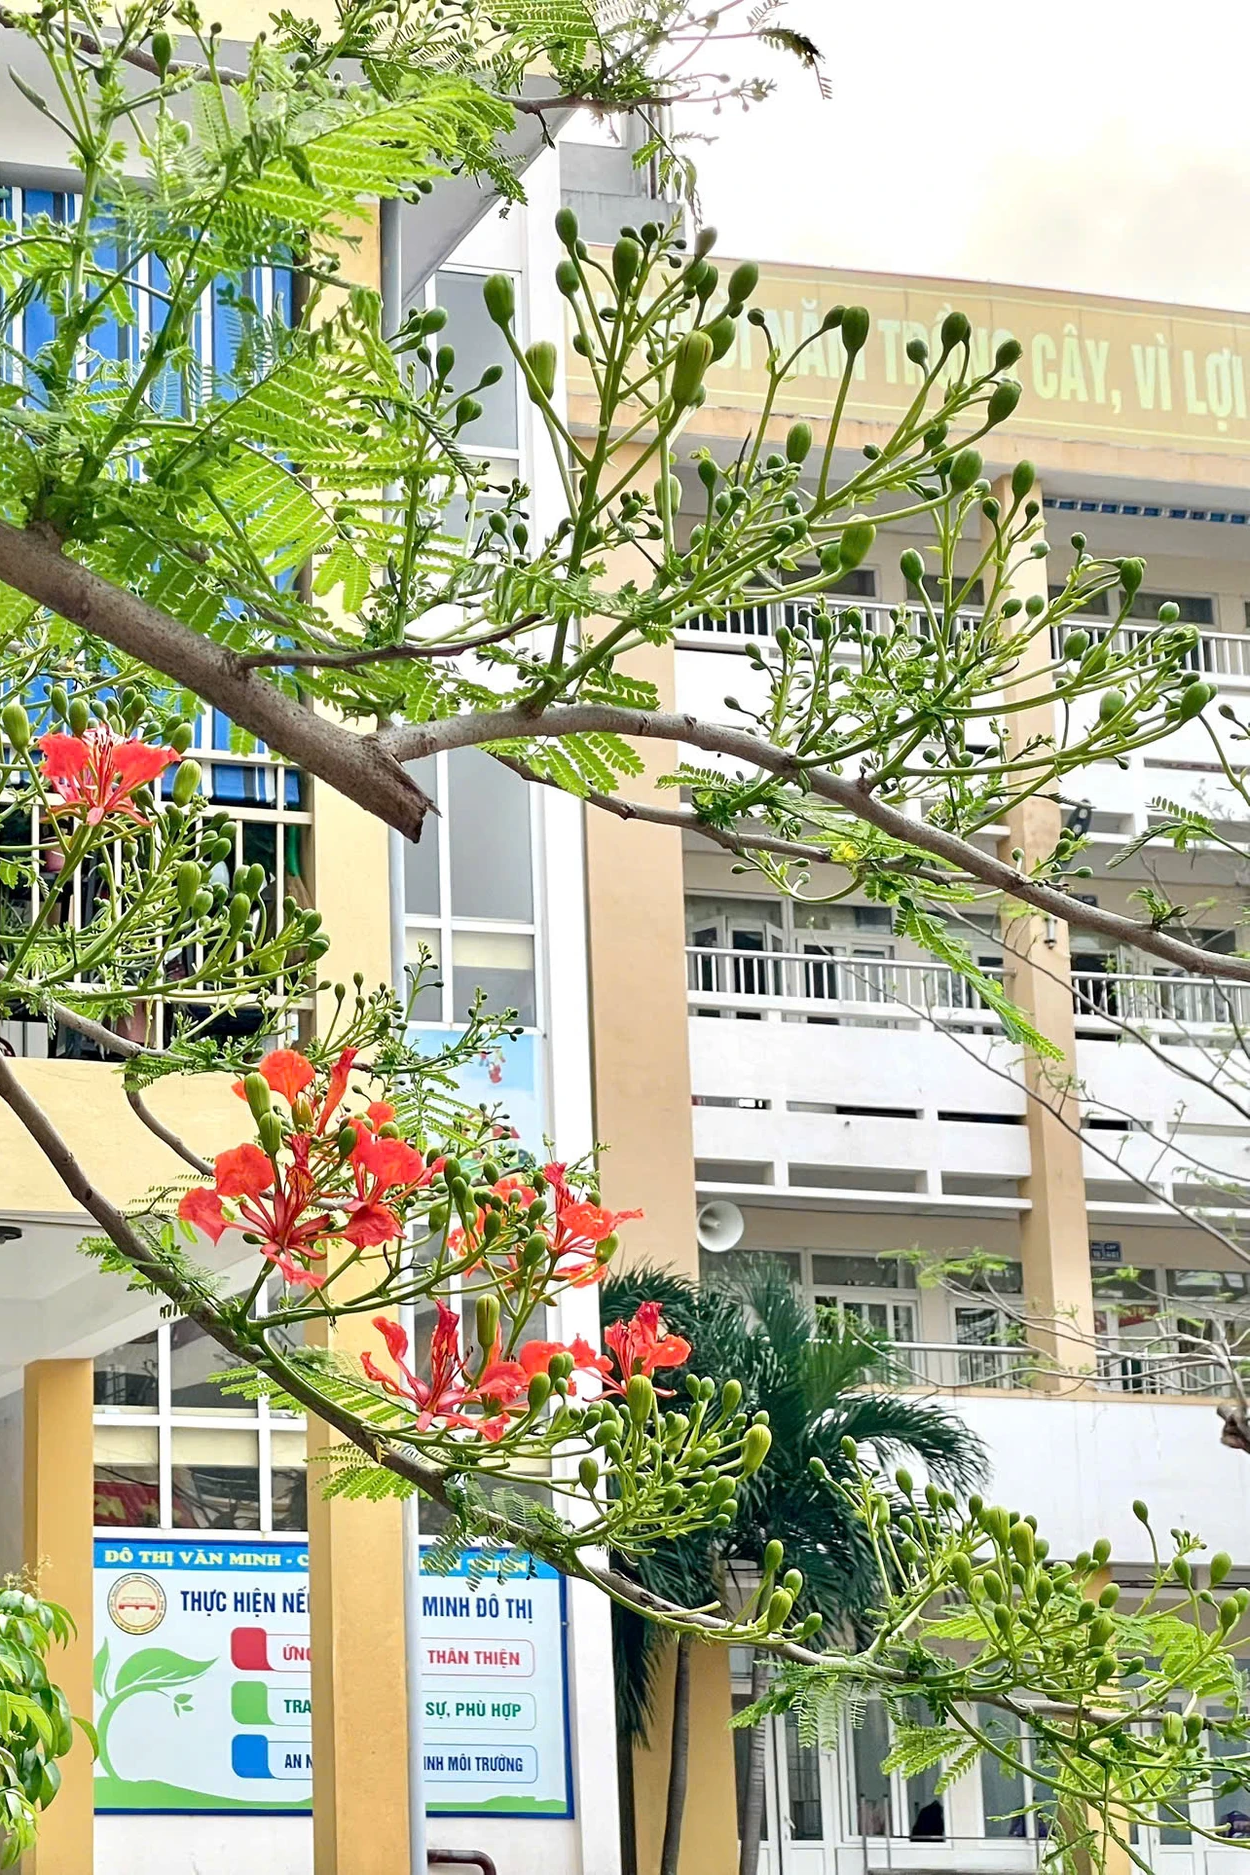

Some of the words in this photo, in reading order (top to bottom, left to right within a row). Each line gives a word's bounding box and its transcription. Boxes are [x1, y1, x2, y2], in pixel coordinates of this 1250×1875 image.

[1031, 322, 1121, 414] CÂY,
[1131, 332, 1172, 411] VÌ
[1182, 347, 1246, 432] LỢI
[104, 1547, 134, 1563] ĐÔ
[138, 1551, 174, 1567] THỊ
[178, 1549, 223, 1565] VĂN
[229, 1552, 281, 1567] MINH
[180, 1588, 227, 1617] THỰC
[233, 1587, 276, 1618] HIỆN
[282, 1585, 310, 1614] NẾ
[423, 1596, 469, 1617] MINH
[476, 1593, 499, 1618] ĐÔ
[506, 1599, 532, 1624] THỊ
[427, 1647, 469, 1665] THÂN
[474, 1648, 520, 1669] THIỆN
[425, 1700, 450, 1719] SỰ,
[455, 1699, 486, 1717] PHÙ
[491, 1702, 521, 1721] HỢP
[284, 1754, 302, 1769] AN
[448, 1753, 471, 1771] MÔI
[475, 1753, 523, 1772] TRƯỜNG
